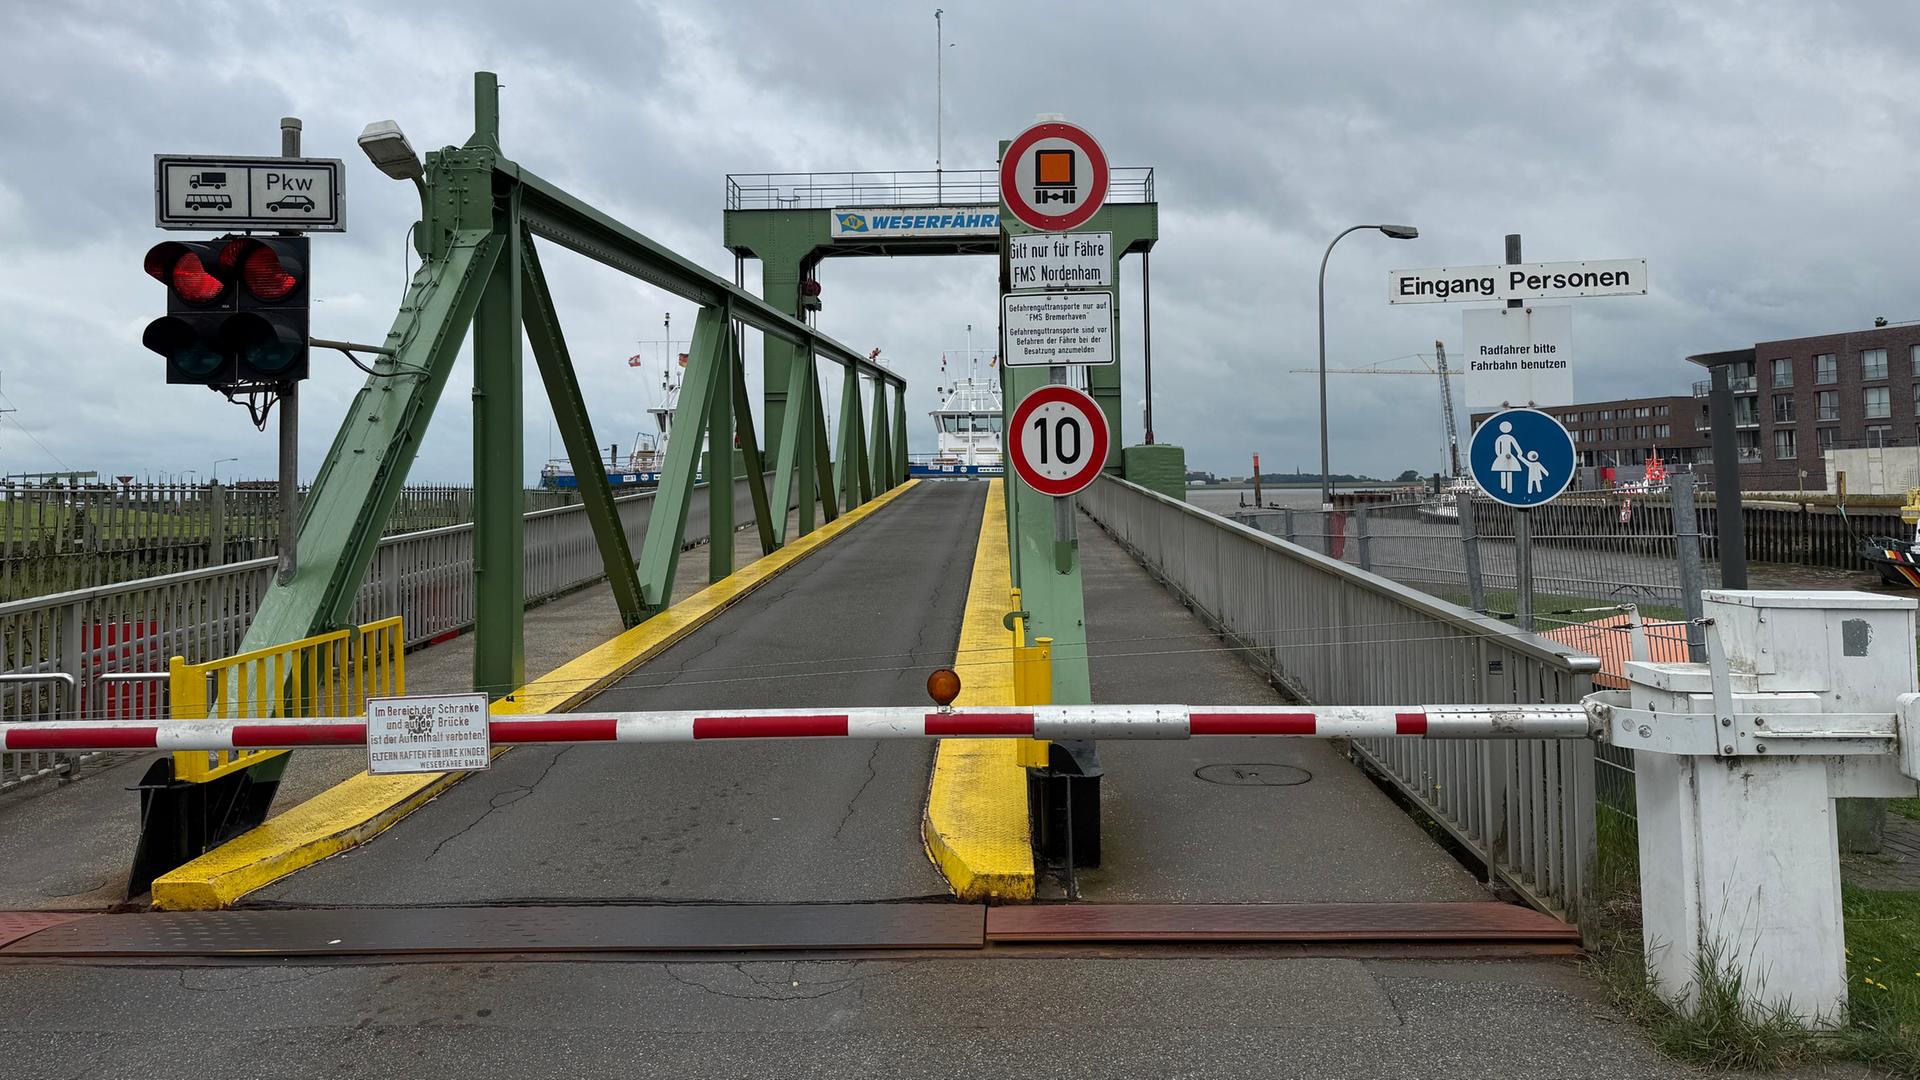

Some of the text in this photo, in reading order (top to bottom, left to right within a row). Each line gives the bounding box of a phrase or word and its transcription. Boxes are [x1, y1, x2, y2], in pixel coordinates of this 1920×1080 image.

[266, 173, 313, 191] Pkw
[1010, 241, 1104, 259] Gilt nur für Fähre
[1014, 264, 1100, 283] FMS Nordenham
[1400, 270, 1630, 298] Eingang Personen
[1009, 303, 1080, 312] Gefahrenguttransporte
[1010, 327, 1079, 336] Gefahrenguttransporte
[1024, 346, 1094, 355] Besatzung anzumelden
[1480, 344, 1556, 356] Radfahrer bitte
[1471, 359, 1566, 371] Fahrbahn benutzen
[1034, 417, 1080, 464] 10
[375, 703, 479, 717] Im Bereich der Schranke
[387, 716, 469, 730] und auf der Brücke
[371, 729, 485, 745] ist der Aufenthalt verboten!
[372, 747, 485, 761] ELTERN HAFTEN FÜR IHRE KINDER
